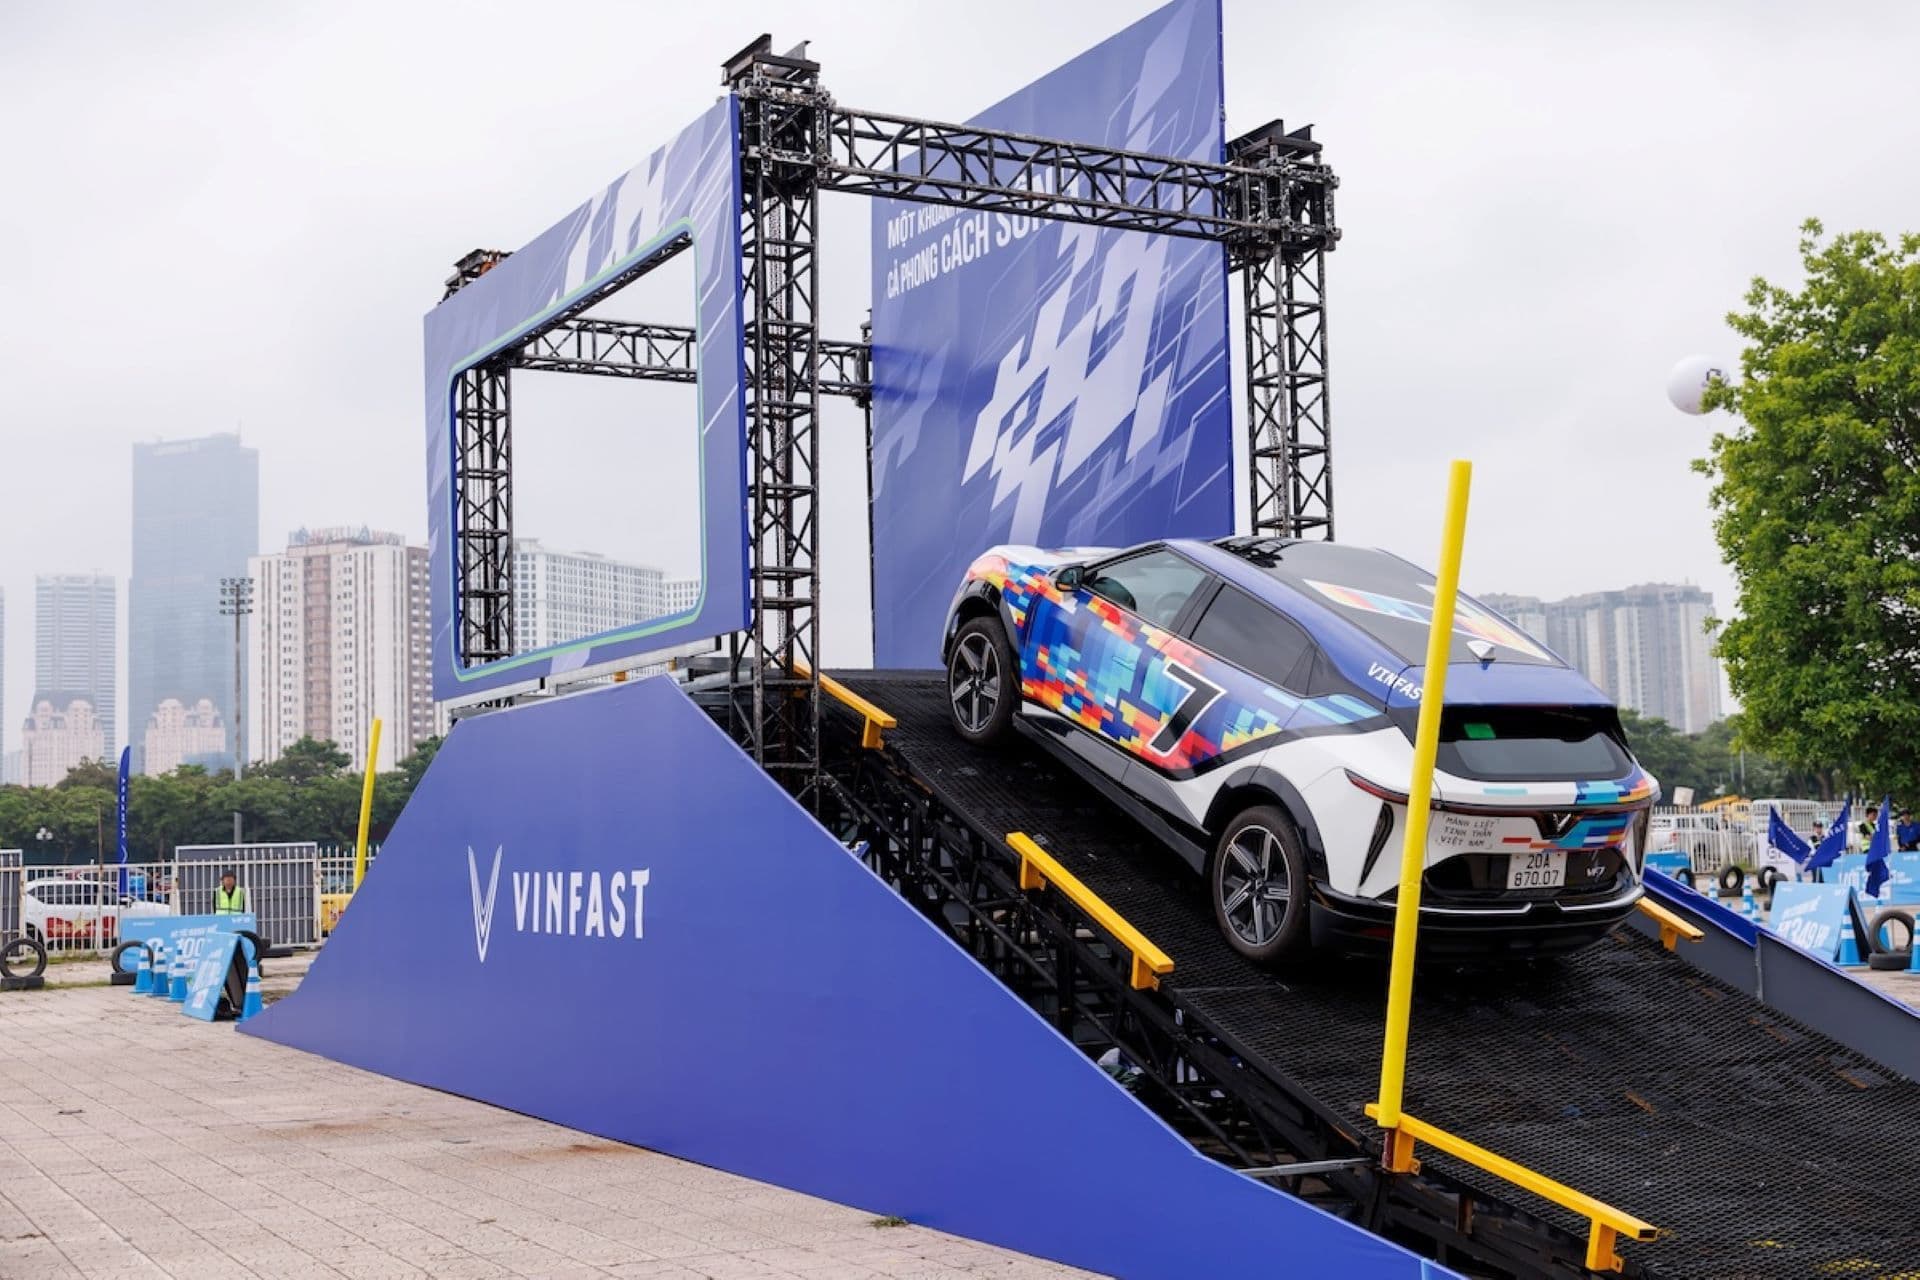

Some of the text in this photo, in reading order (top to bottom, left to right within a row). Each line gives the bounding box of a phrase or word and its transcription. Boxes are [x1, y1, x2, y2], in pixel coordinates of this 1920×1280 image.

[888, 209, 916, 249] MỘT
[900, 242, 938, 293] PHONG
[941, 213, 990, 274] CÁCH
[1367, 662, 1424, 700] VINFAS
[1148, 661, 1227, 757] 7
[1513, 870, 1560, 887] 870.07
[1526, 853, 1551, 869] 20A
[512, 866, 650, 940] VINFAST
